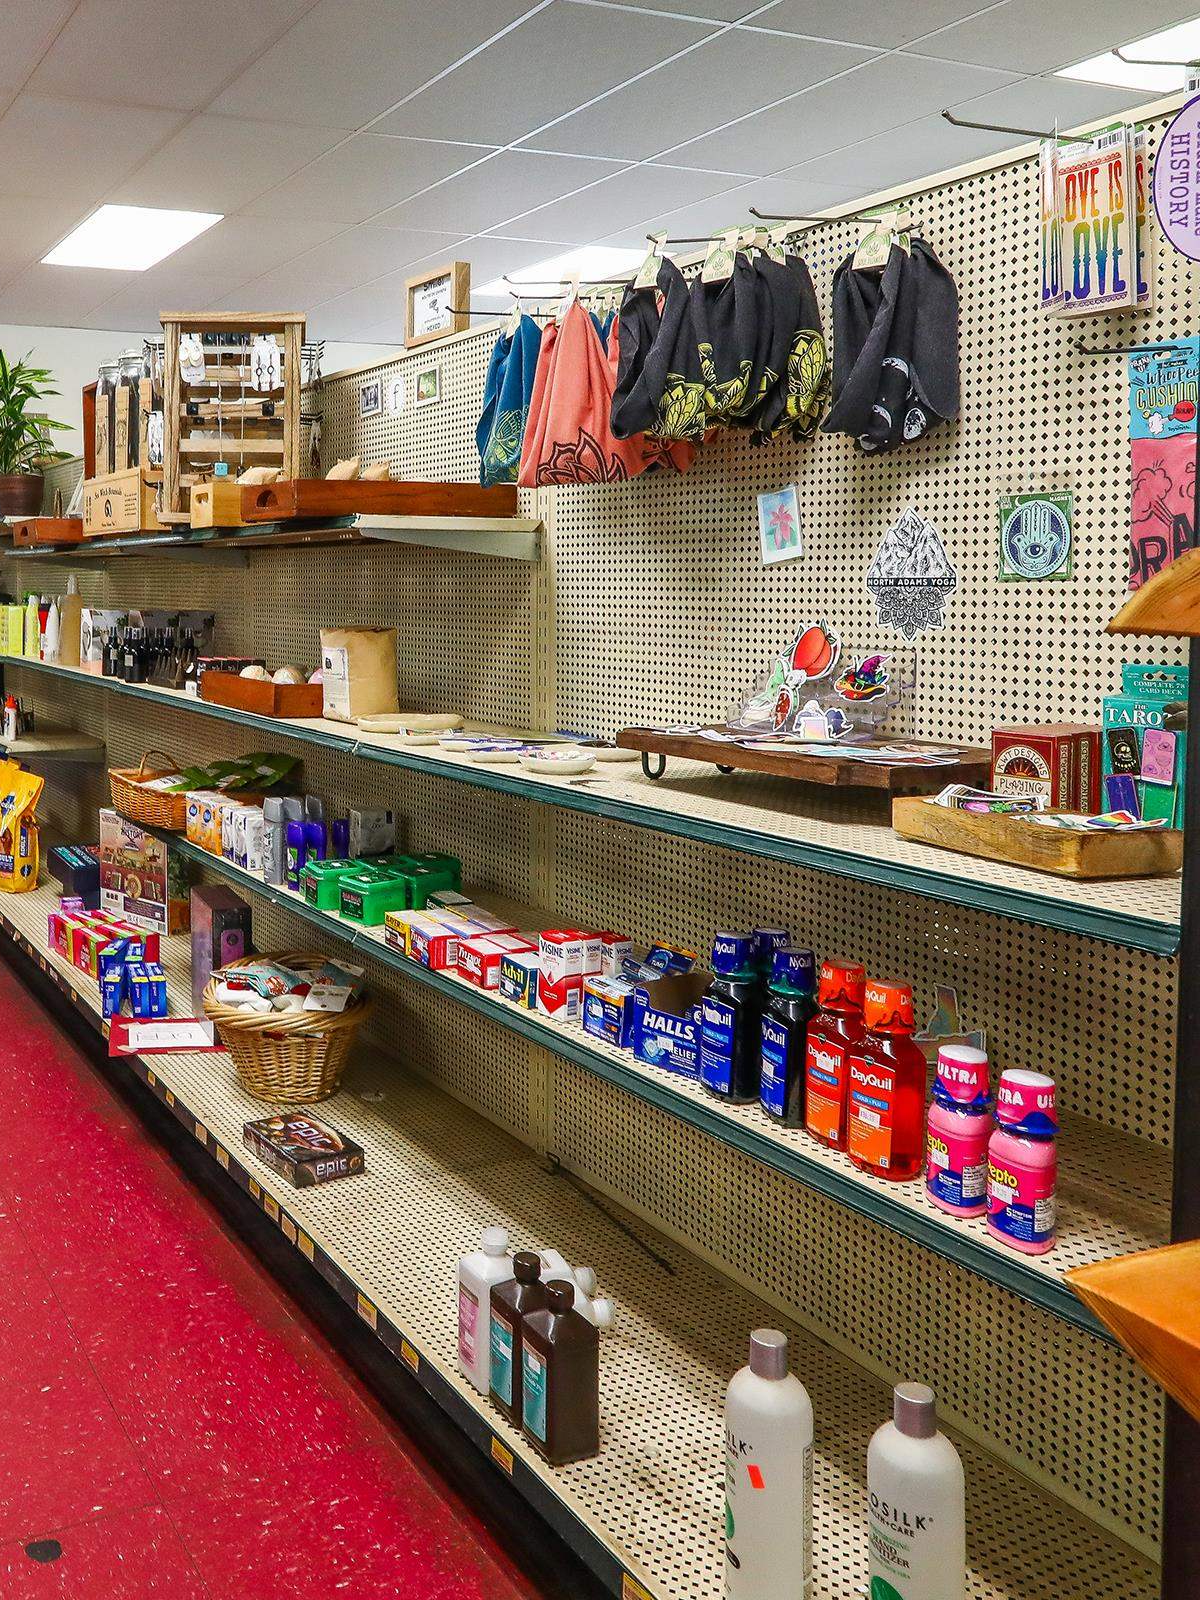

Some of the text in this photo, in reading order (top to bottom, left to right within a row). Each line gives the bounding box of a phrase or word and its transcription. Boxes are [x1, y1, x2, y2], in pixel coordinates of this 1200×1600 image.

[1108, 160, 1124, 212] IS
[1168, 133, 1191, 228] HISTORY
[1062, 212, 1126, 301] OVE
[1049, 494, 1072, 502] MAGNET
[867, 578, 956, 587] NORTH ADAMS YOGA
[1133, 680, 1175, 689] COMPLETE
[1161, 688, 1183, 696] DECK
[1105, 708, 1173, 726] TARO
[997, 748, 1048, 776] KWT DESIGNS
[1000, 778, 1044, 794] PLAYING
[502, 961, 524, 984] Advil
[851, 1065, 892, 1091] DayQuil
[937, 1062, 978, 1086] ULTRA
[287, 1121, 332, 1148] epic
[316, 1158, 348, 1178] epic
[1005, 1206, 1012, 1217] 5
